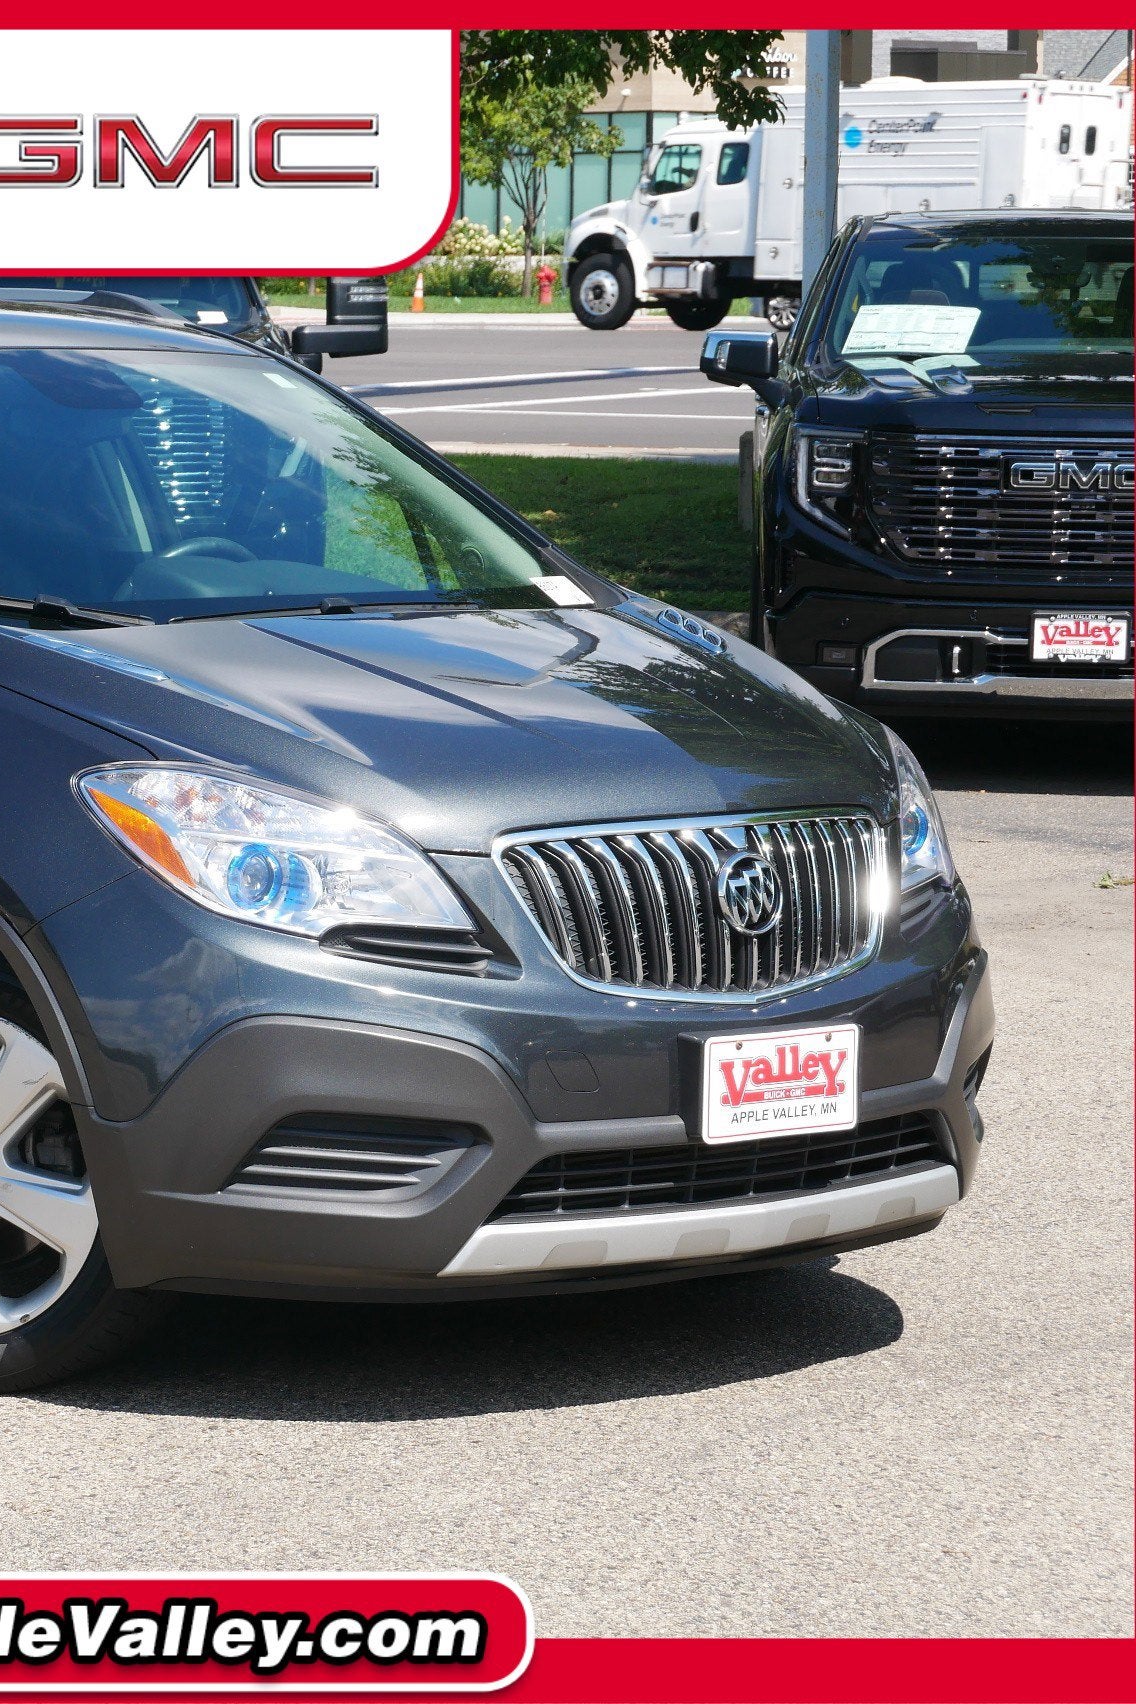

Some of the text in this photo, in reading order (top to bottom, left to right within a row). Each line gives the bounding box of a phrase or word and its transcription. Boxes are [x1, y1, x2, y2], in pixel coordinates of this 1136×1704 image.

[1040, 620, 1122, 647] Valley
[719, 1045, 848, 1107] Valley
[764, 1087, 806, 1100] BUICK GMC
[730, 1101, 838, 1125] APPLE VALLEY, MN
